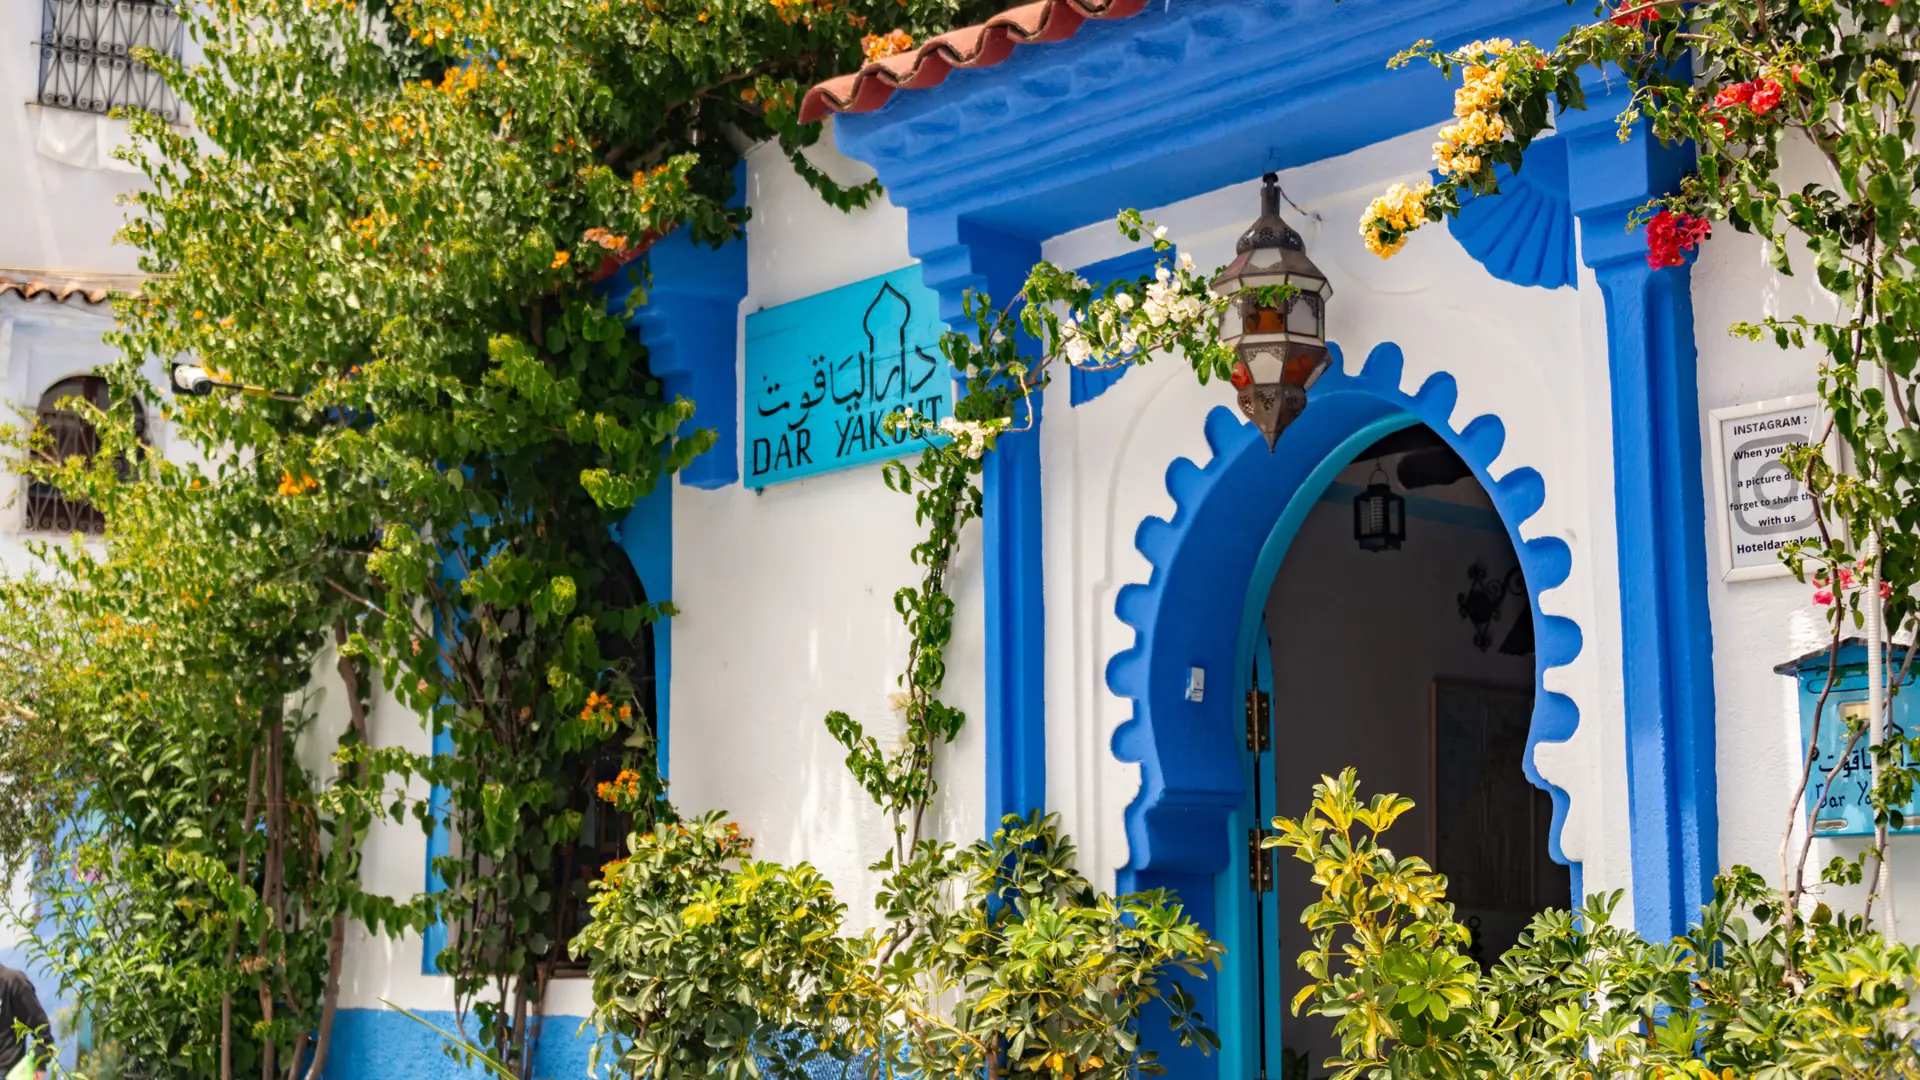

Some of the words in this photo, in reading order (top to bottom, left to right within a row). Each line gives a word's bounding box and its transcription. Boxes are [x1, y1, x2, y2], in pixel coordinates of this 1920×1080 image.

[875, 345, 936, 402] دار
[1733, 415, 1801, 436] INSTAGRAM
[752, 428, 813, 476] DAR
[1733, 449, 1762, 460] When
[1764, 446, 1783, 458] you
[1746, 474, 1782, 489] picture
[1730, 501, 1759, 512] forget
[1760, 499, 1770, 507] to
[1772, 495, 1799, 506] share
[1801, 490, 1827, 501] thm
[1758, 516, 1781, 527] with
[1784, 515, 1796, 523] us
